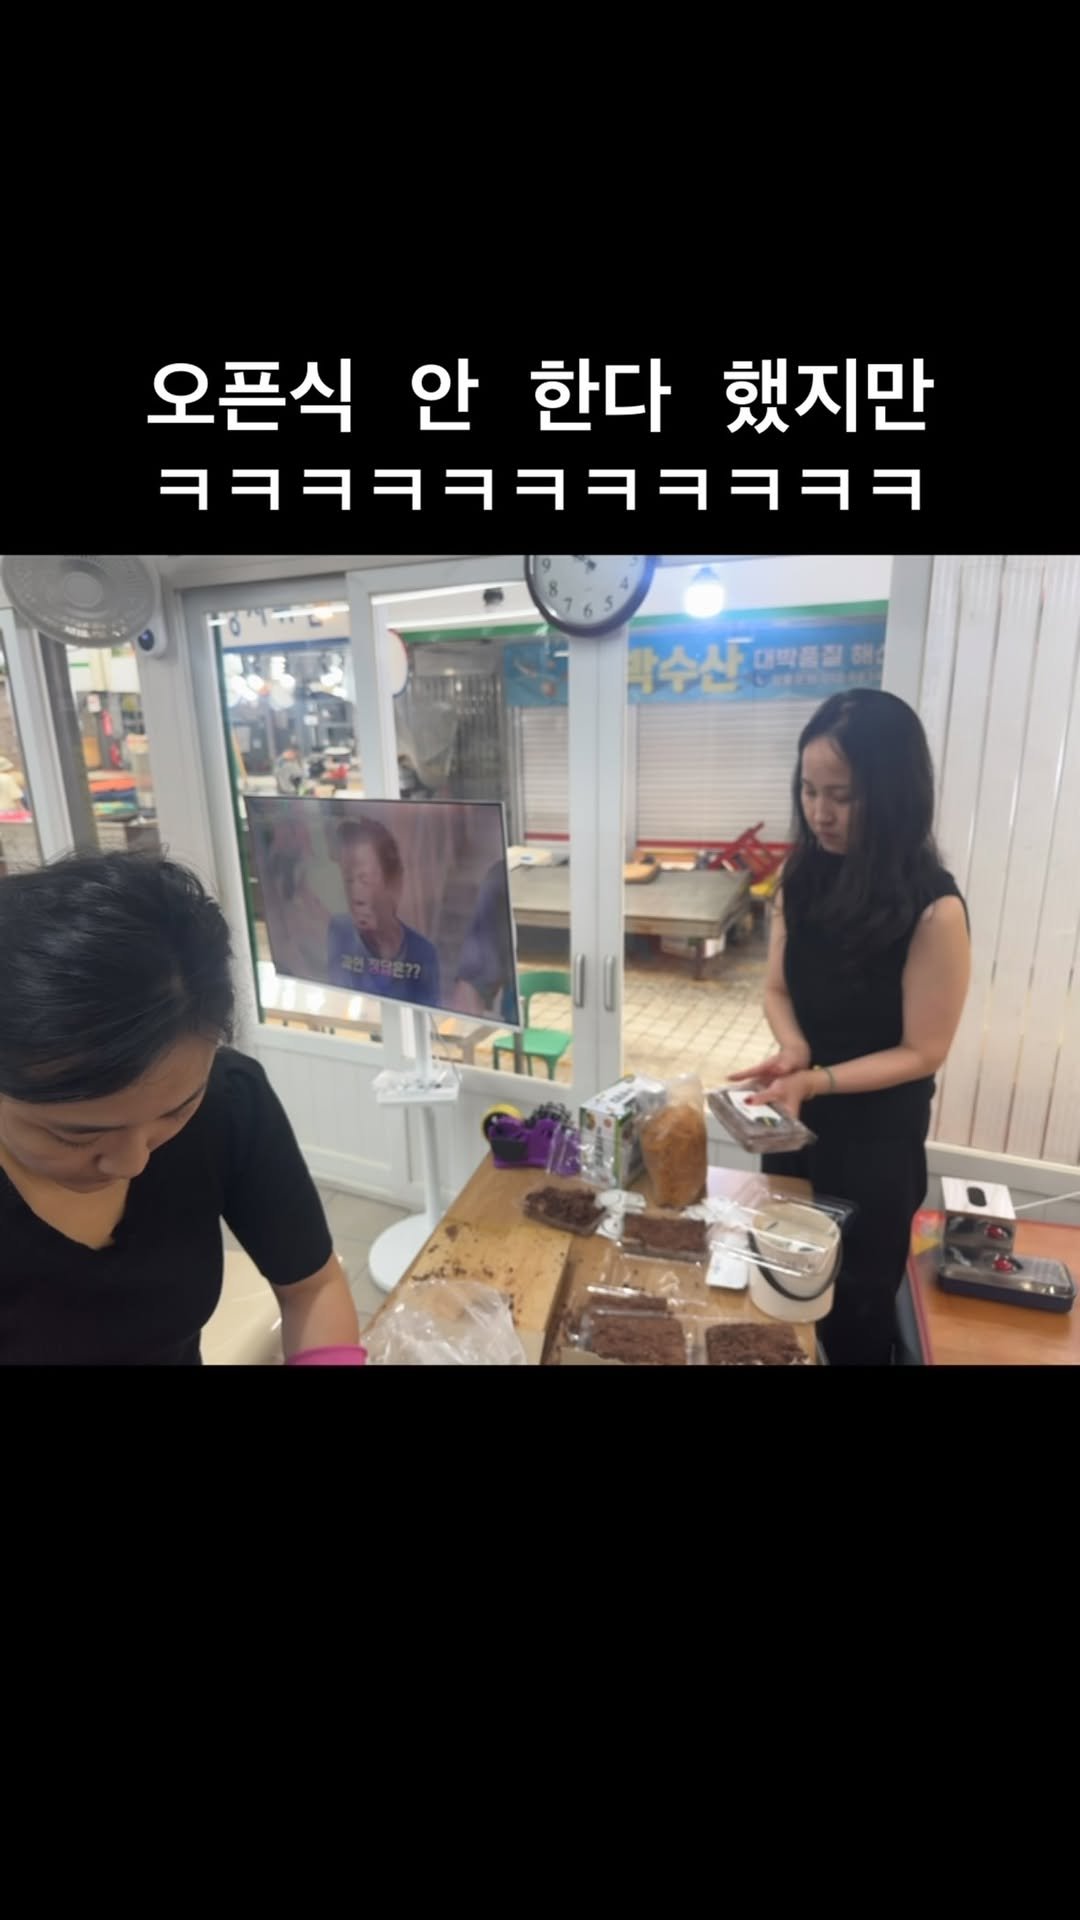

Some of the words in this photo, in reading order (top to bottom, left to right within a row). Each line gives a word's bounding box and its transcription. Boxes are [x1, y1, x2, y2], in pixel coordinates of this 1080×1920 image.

[542, 557, 551, 573] 9
[548, 580, 558, 597] 8
[619, 576, 629, 590] 4
[563, 597, 572, 613] 7
[583, 603, 593, 618] 6
[604, 595, 613, 612] 5
